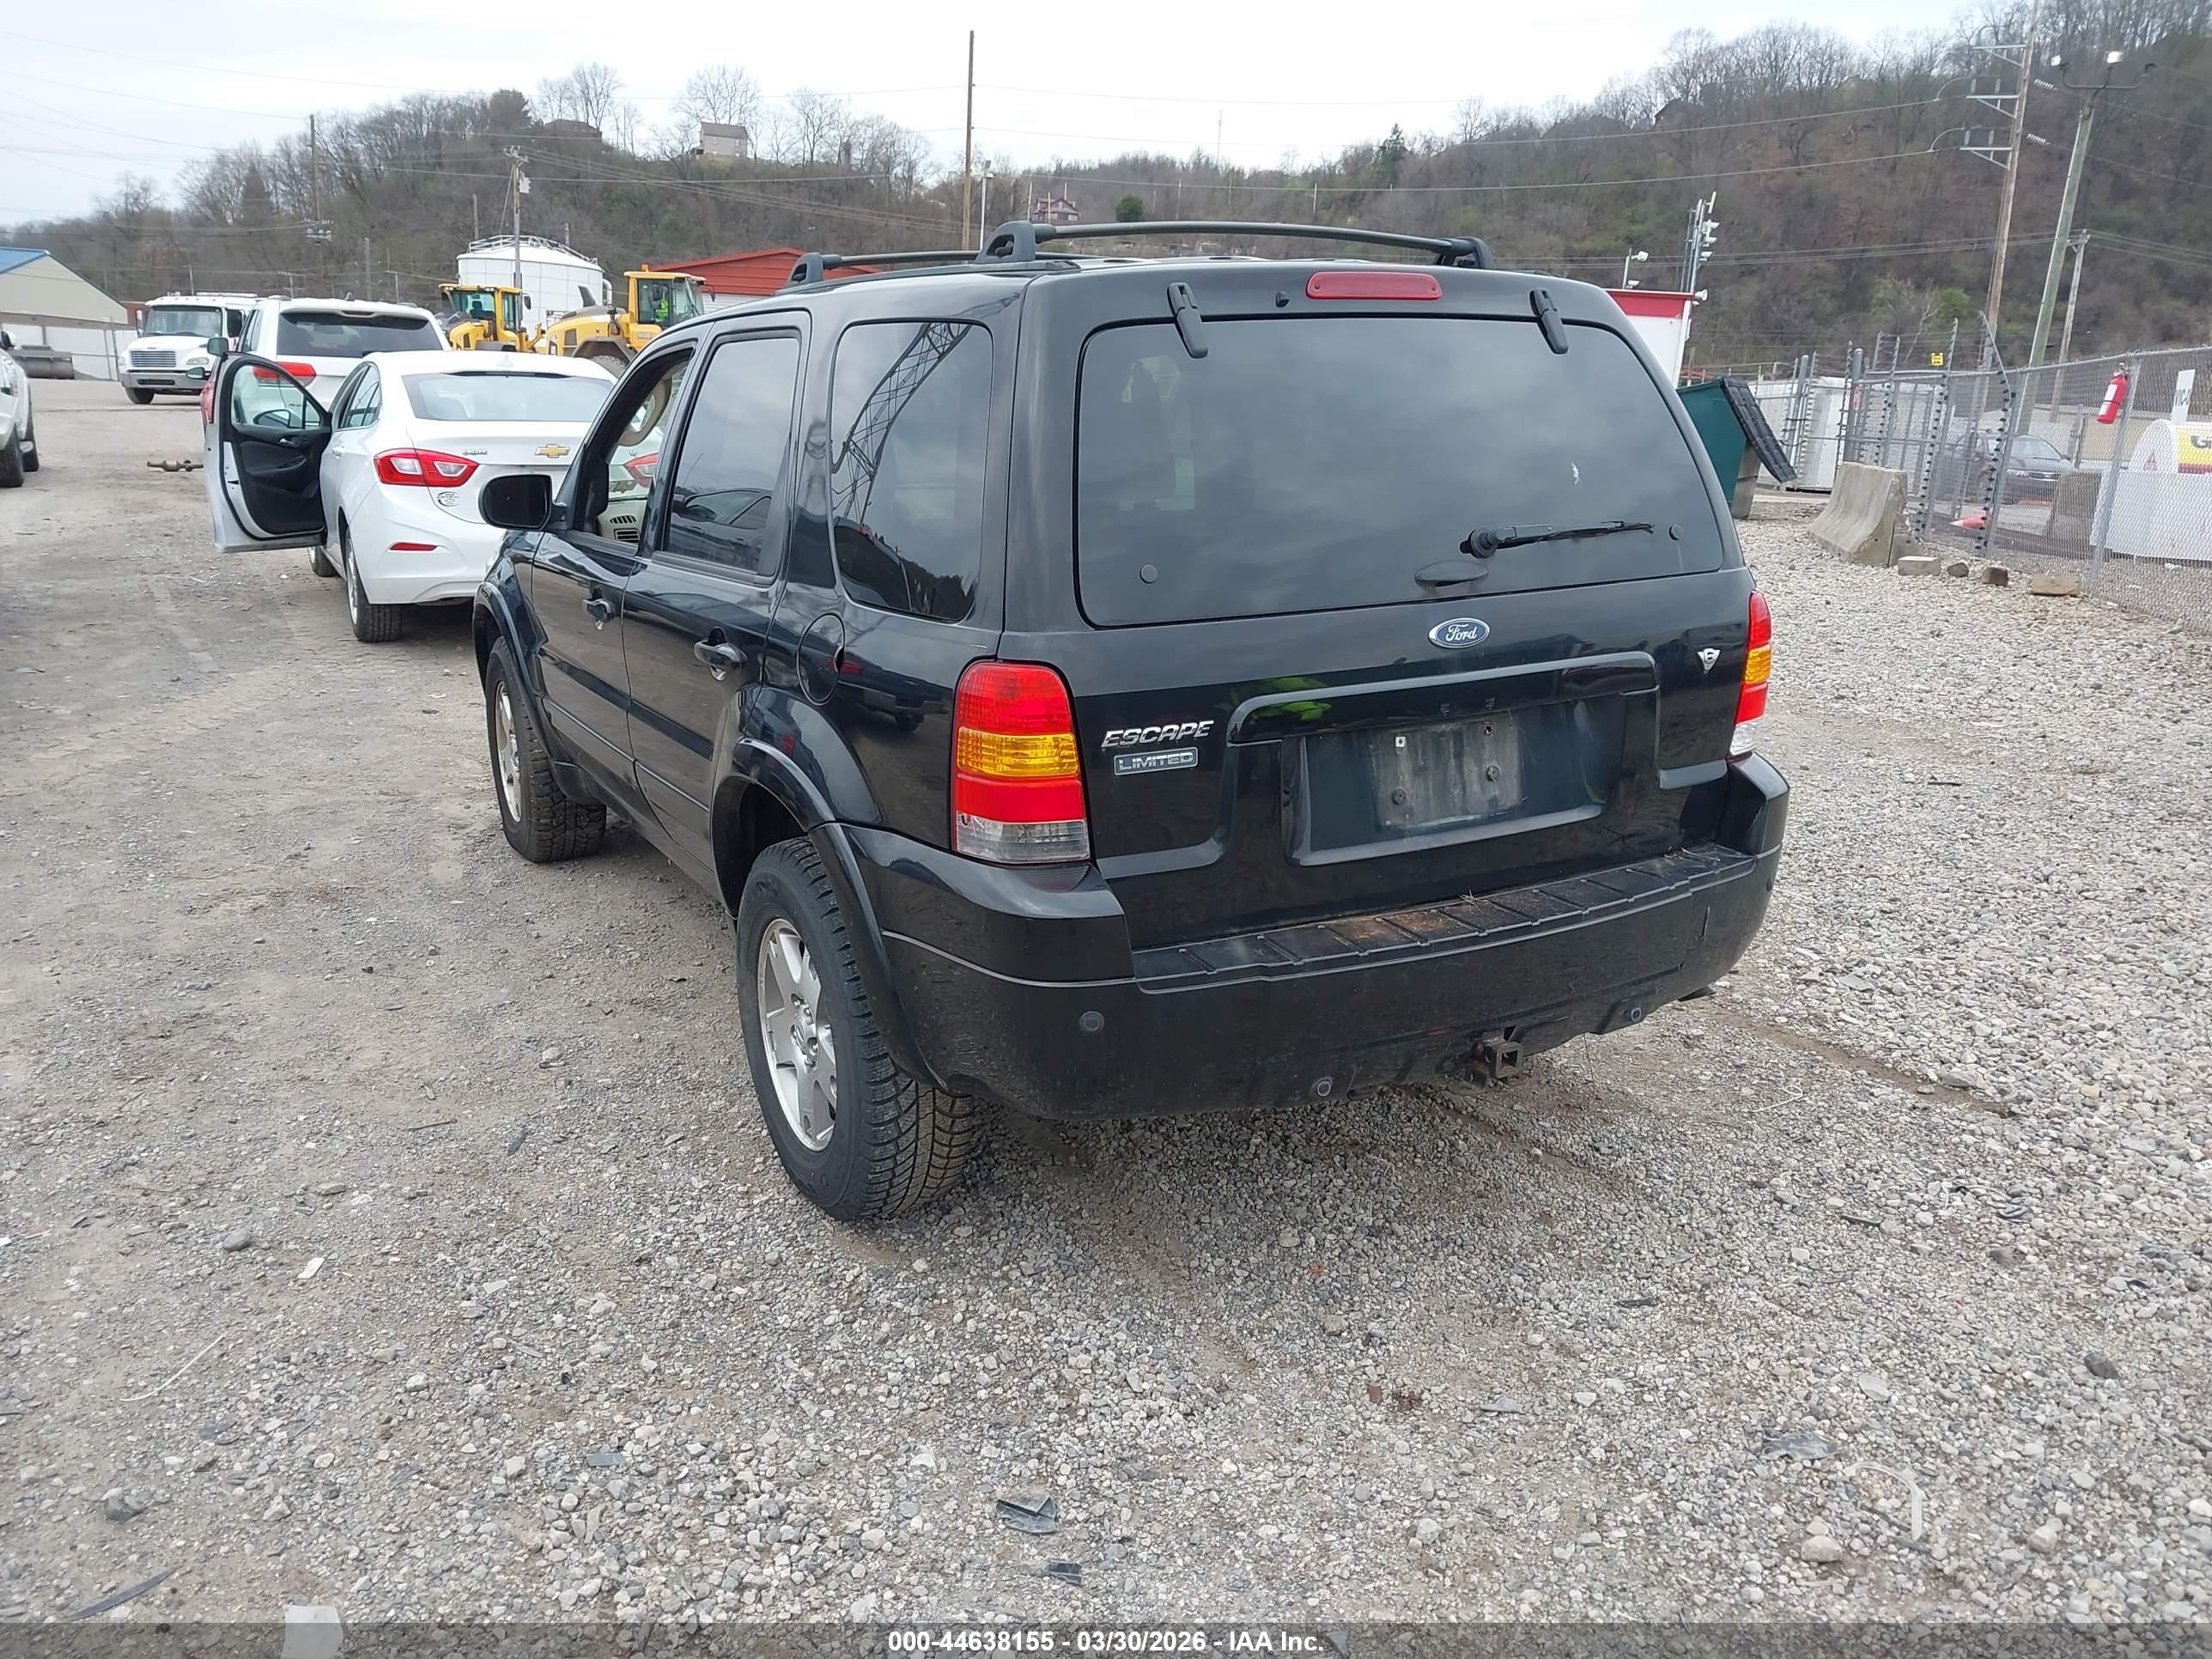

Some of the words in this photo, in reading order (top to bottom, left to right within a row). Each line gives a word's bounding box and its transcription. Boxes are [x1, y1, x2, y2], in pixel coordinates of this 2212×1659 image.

[1445, 623, 1478, 641] Ford
[1101, 720, 1214, 748] ESCAPE
[1119, 752, 1194, 771] LIMITED
